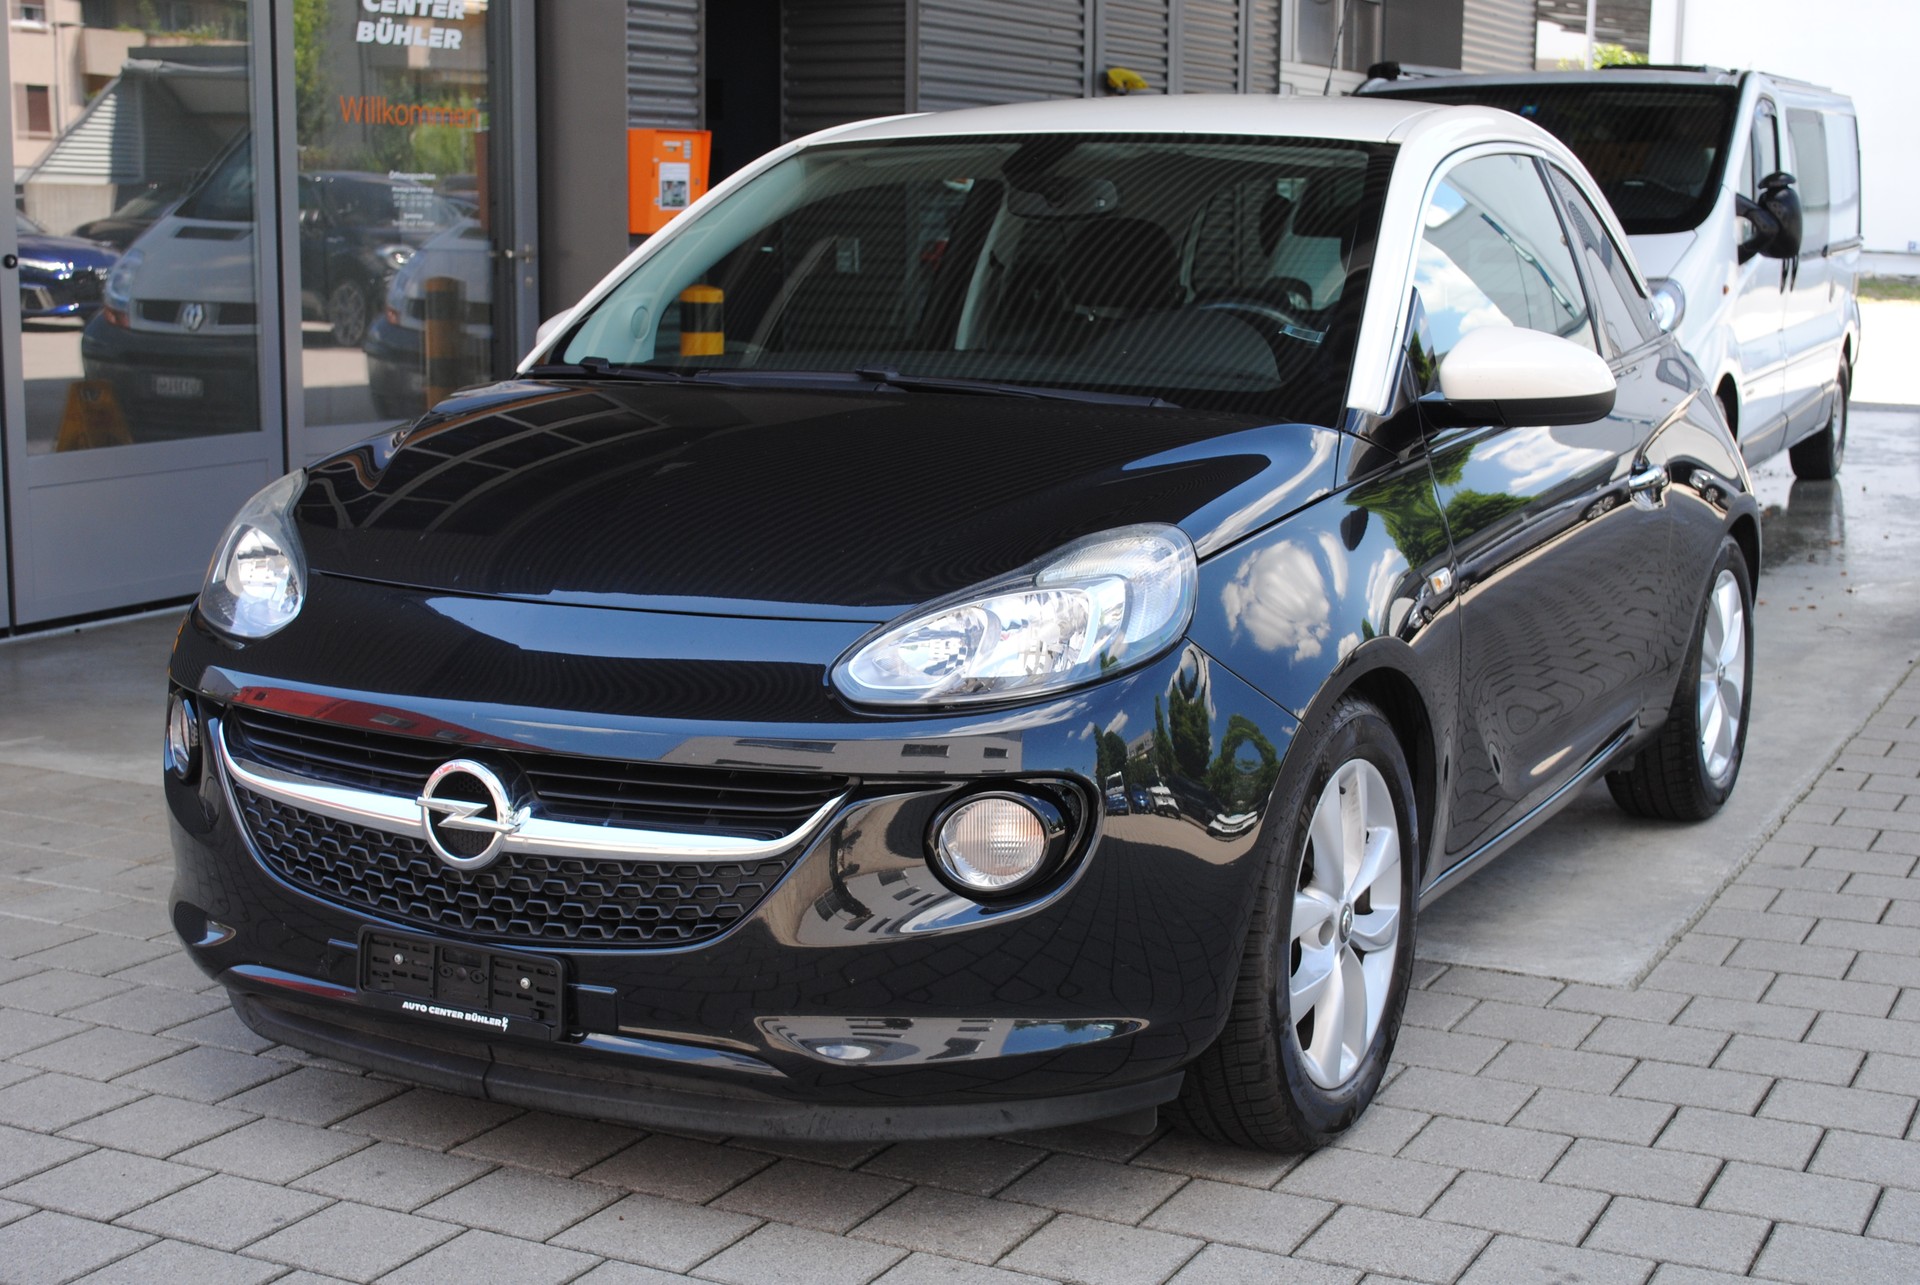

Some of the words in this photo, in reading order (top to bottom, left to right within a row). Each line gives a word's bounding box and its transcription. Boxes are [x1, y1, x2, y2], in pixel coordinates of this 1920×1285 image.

[362, 0, 464, 20] CENTER
[356, 17, 463, 50] BÜHLER
[340, 95, 480, 128] Willkommen
[402, 1001, 427, 1013] AUTO
[428, 1006, 464, 1020] CENTER
[464, 1012, 502, 1027] BÜHLER
